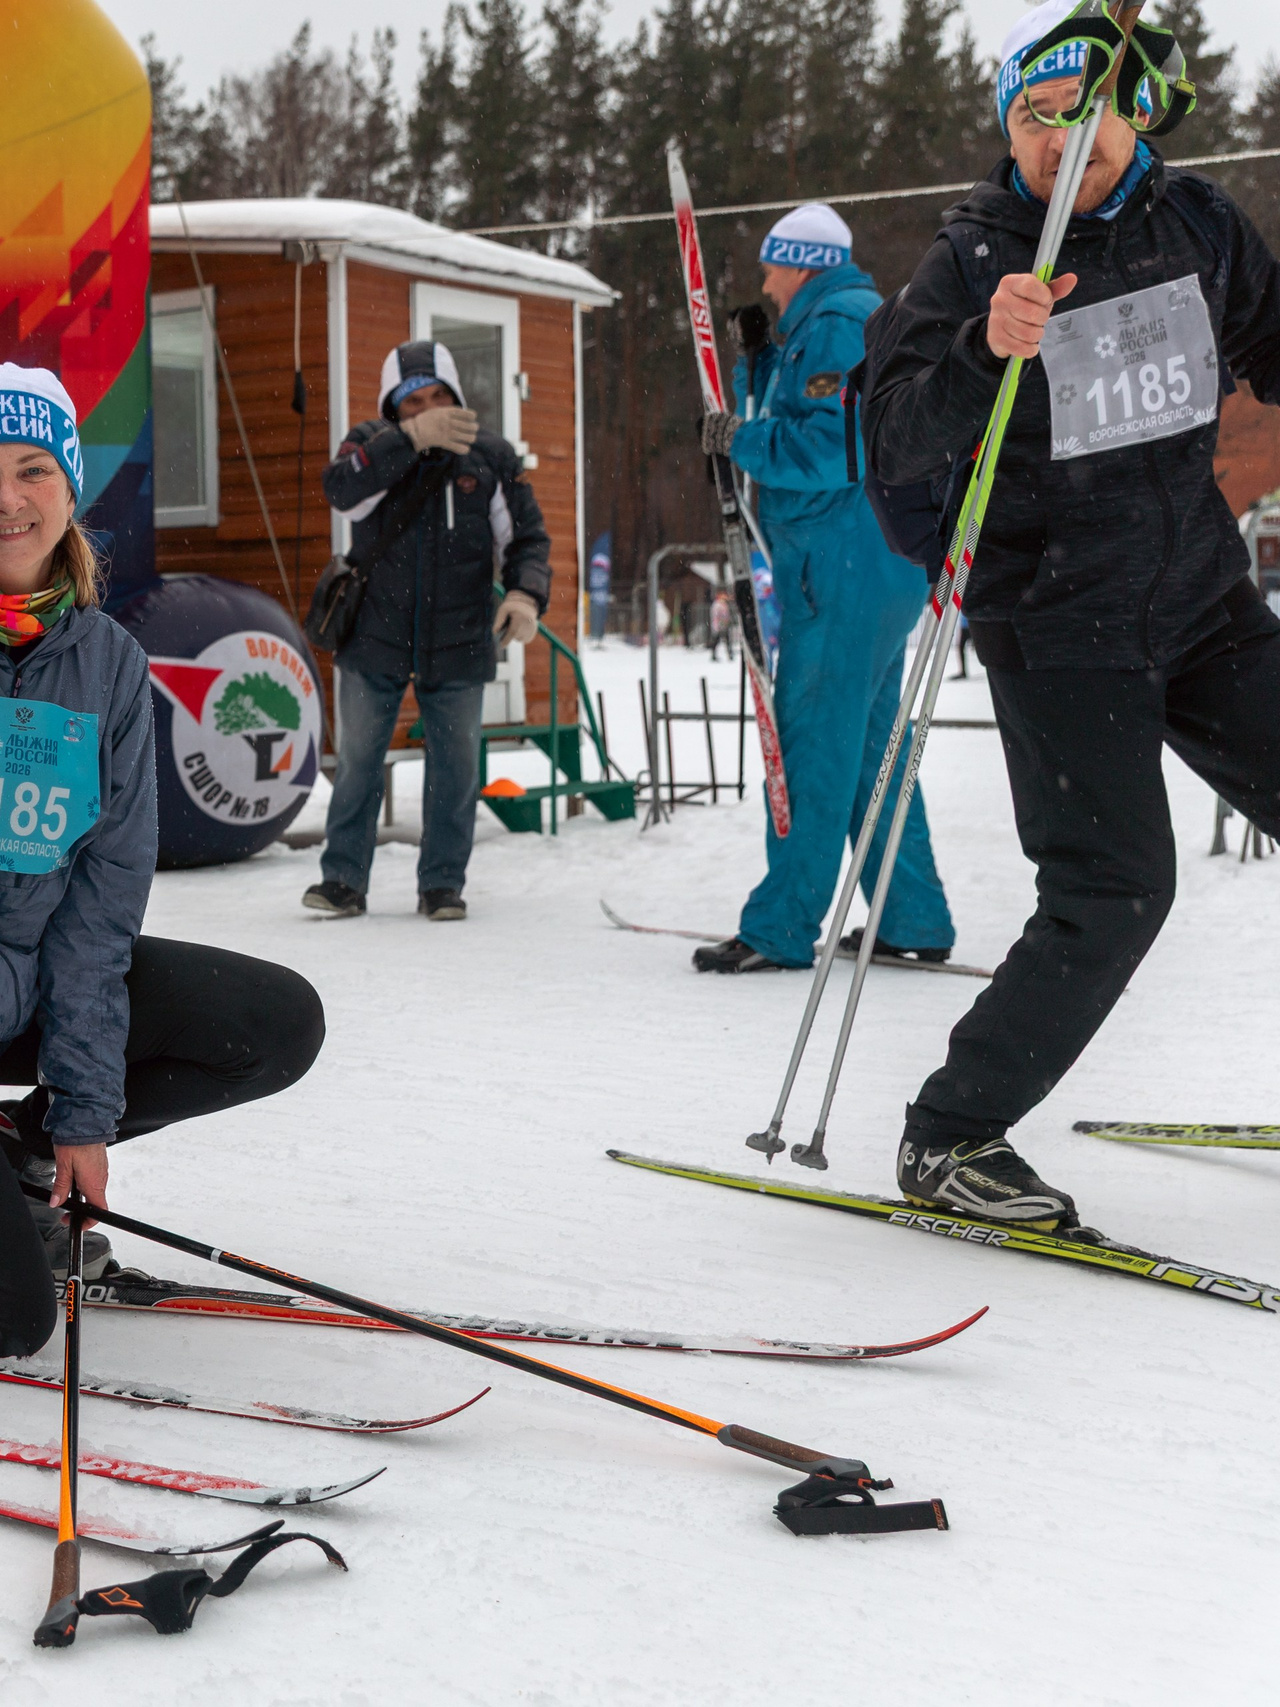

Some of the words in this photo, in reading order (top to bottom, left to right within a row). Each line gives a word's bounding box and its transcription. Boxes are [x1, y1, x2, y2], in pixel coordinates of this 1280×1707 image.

[771, 241, 842, 267] 2026
[691, 290, 714, 349] TISA
[1120, 318, 1166, 341] ЛЫЖНЯ
[1120, 330, 1168, 353] РОССИИ
[1124, 351, 1147, 366] 2026
[1086, 354, 1191, 426] 1185
[1089, 418, 1158, 443] ВОРОНЕЖСКАЯ
[1158, 404, 1195, 424] ОБЛАСТЬ
[245, 637, 315, 698] ВОРОНЕЖ
[5, 746, 59, 766] РОССИИ
[6, 733, 59, 753] ЛЫЖНЯ
[5, 761, 31, 776] 2026
[183, 751, 230, 811] СШОР
[252, 796, 270, 818] 18
[20, 840, 61, 858] ОБЛАСТЬ
[958, 1166, 1023, 1198] FISCHER
[888, 1210, 1011, 1248] FISCHER
